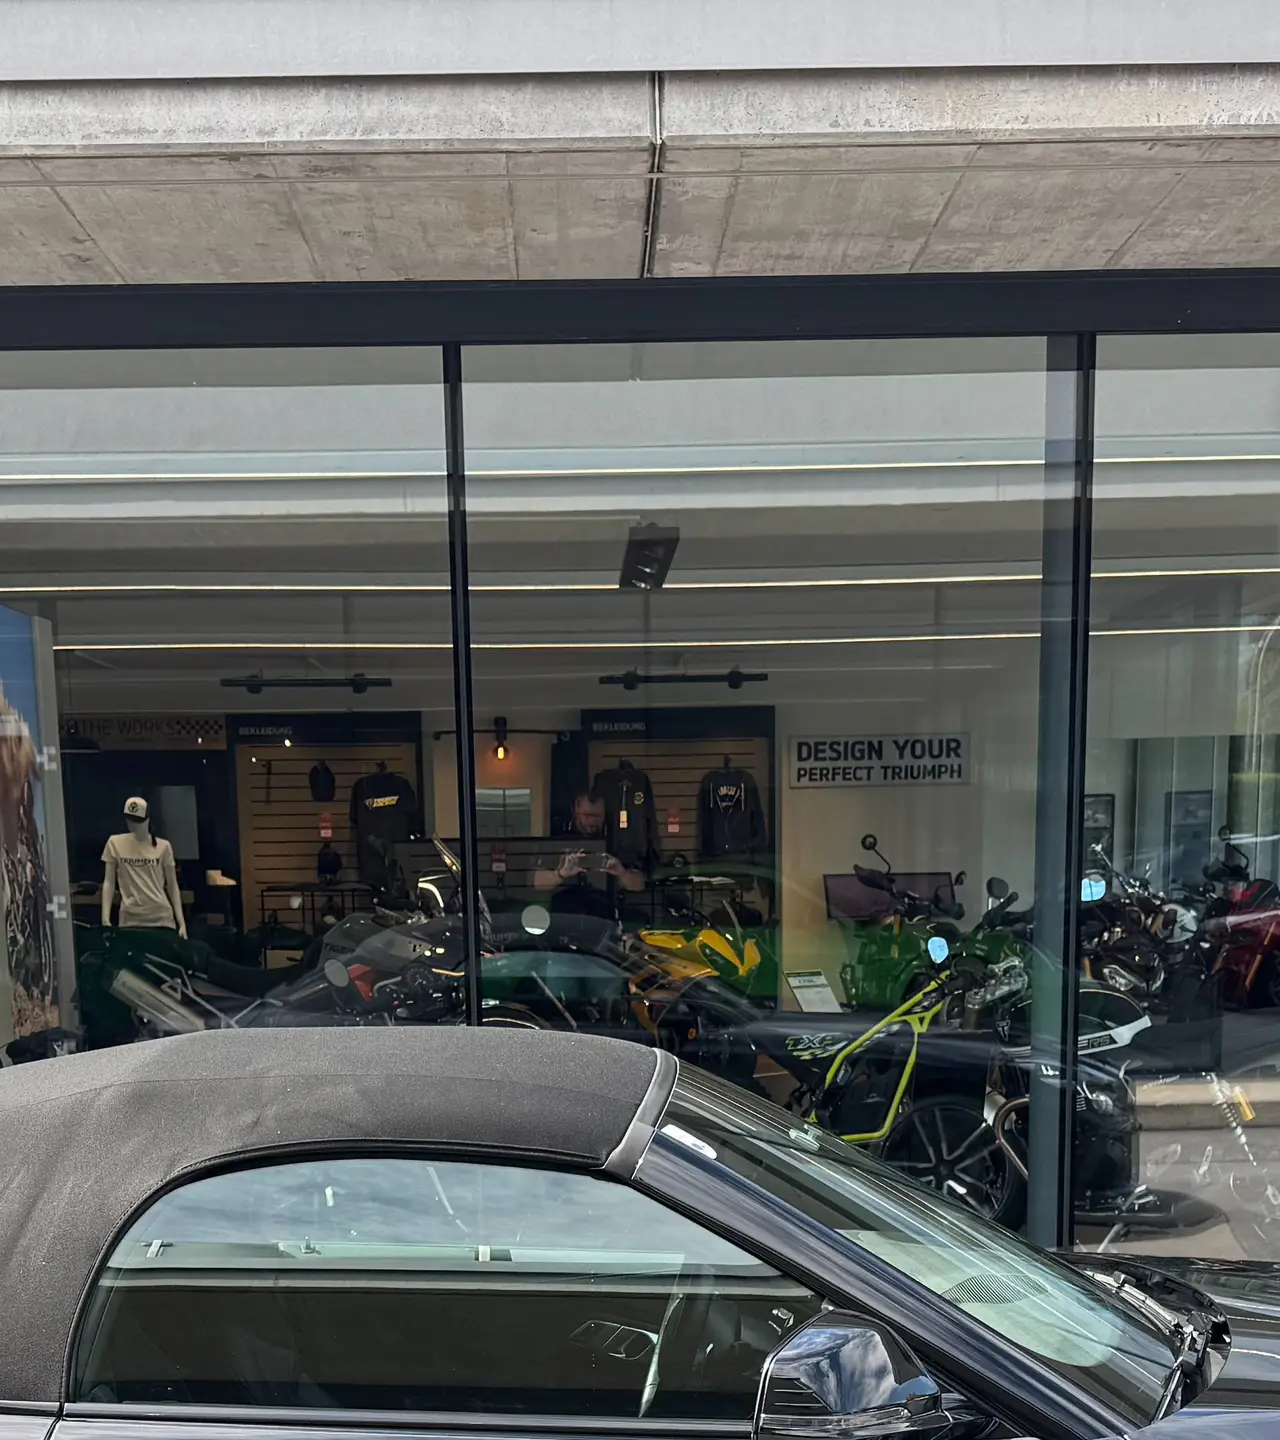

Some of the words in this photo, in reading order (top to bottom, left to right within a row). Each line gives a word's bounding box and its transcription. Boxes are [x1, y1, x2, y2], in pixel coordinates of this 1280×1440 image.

[592, 722, 646, 732] BEKLEIDUNG
[796, 740, 884, 762] DESIGN
[892, 738, 962, 760] YOUR
[796, 766, 875, 783] PERFECT
[880, 764, 962, 781] TRIUMPH
